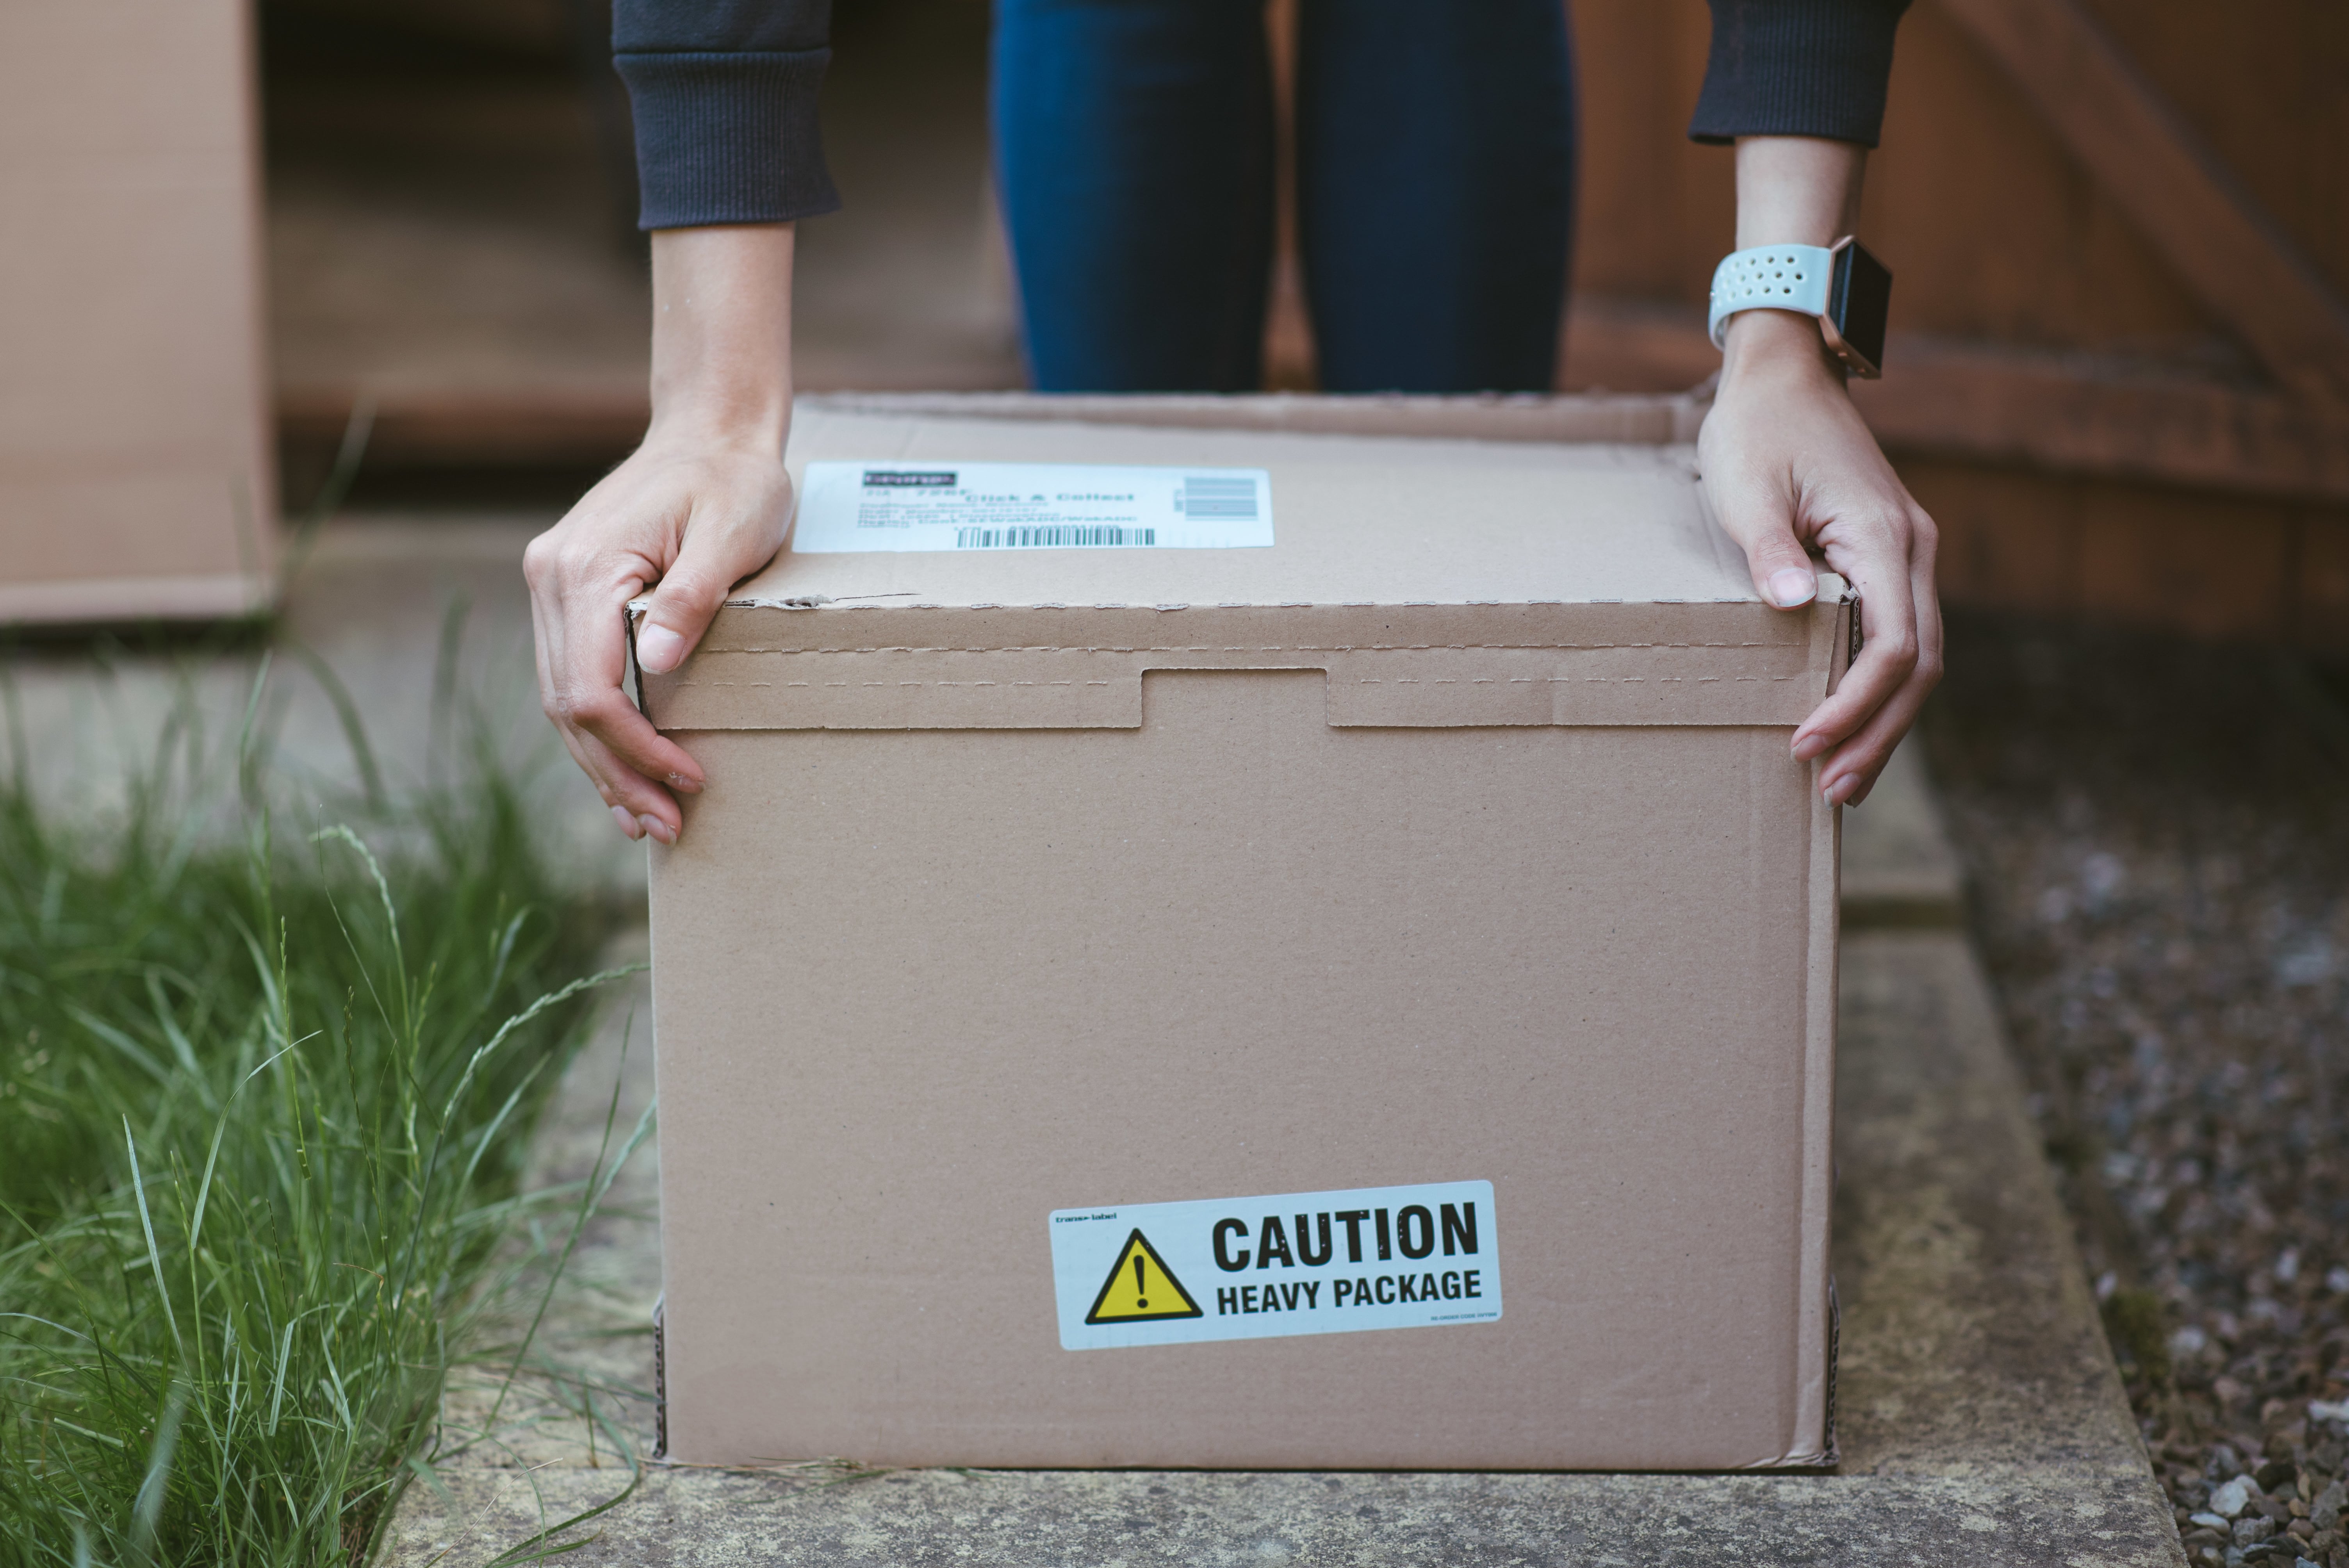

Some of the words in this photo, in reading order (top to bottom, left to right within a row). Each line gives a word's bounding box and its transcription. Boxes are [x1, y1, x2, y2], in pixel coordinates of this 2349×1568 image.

[965, 494, 1019, 502] Click
[1212, 1201, 1479, 1273] CAUTION
[1217, 1281, 1321, 1316] HEAVY
[1333, 1269, 1482, 1308] PACKAGE
